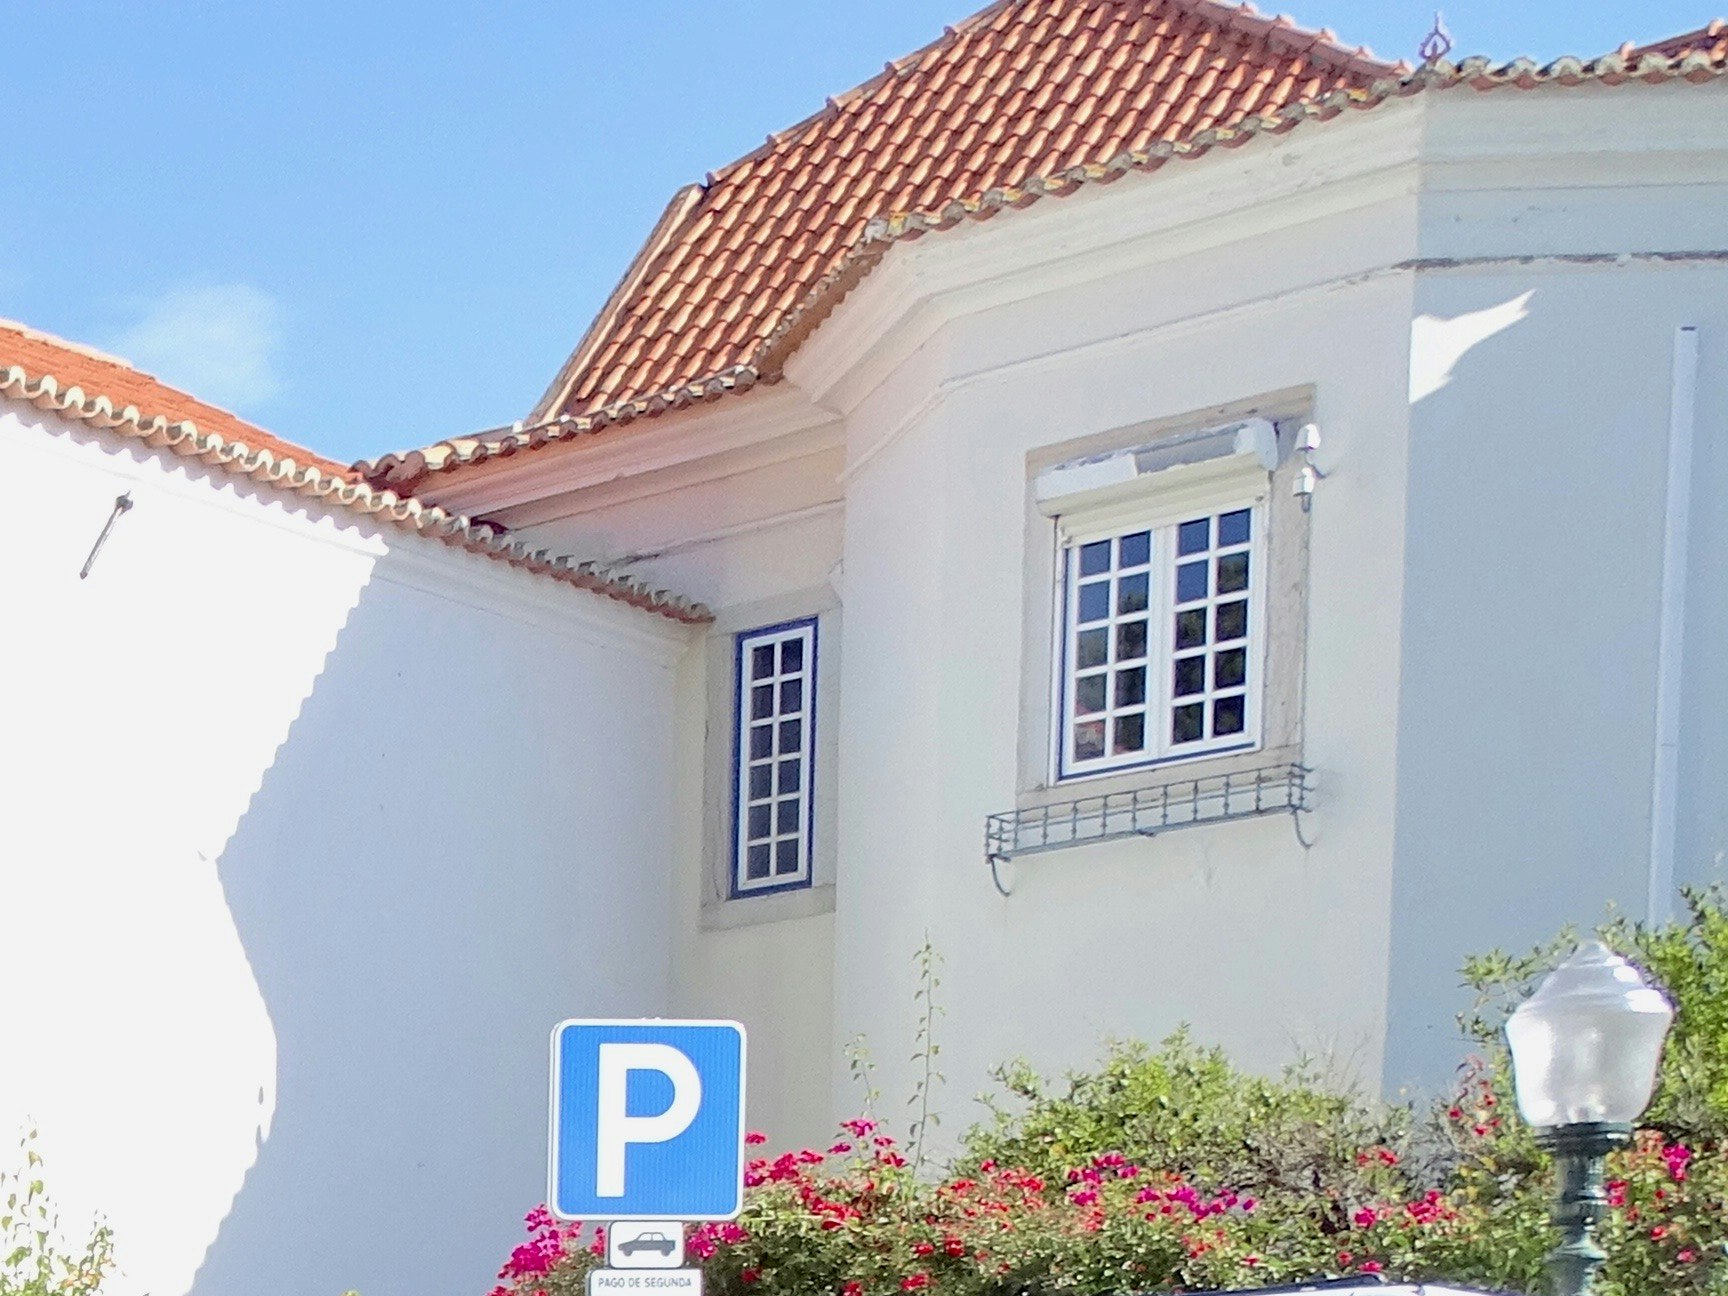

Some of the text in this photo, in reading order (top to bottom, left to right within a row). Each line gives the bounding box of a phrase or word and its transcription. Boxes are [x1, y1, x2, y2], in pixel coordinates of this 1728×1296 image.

[596, 1042, 702, 1198] P
[598, 1277, 692, 1288] PAGO DE SEGUNDA
